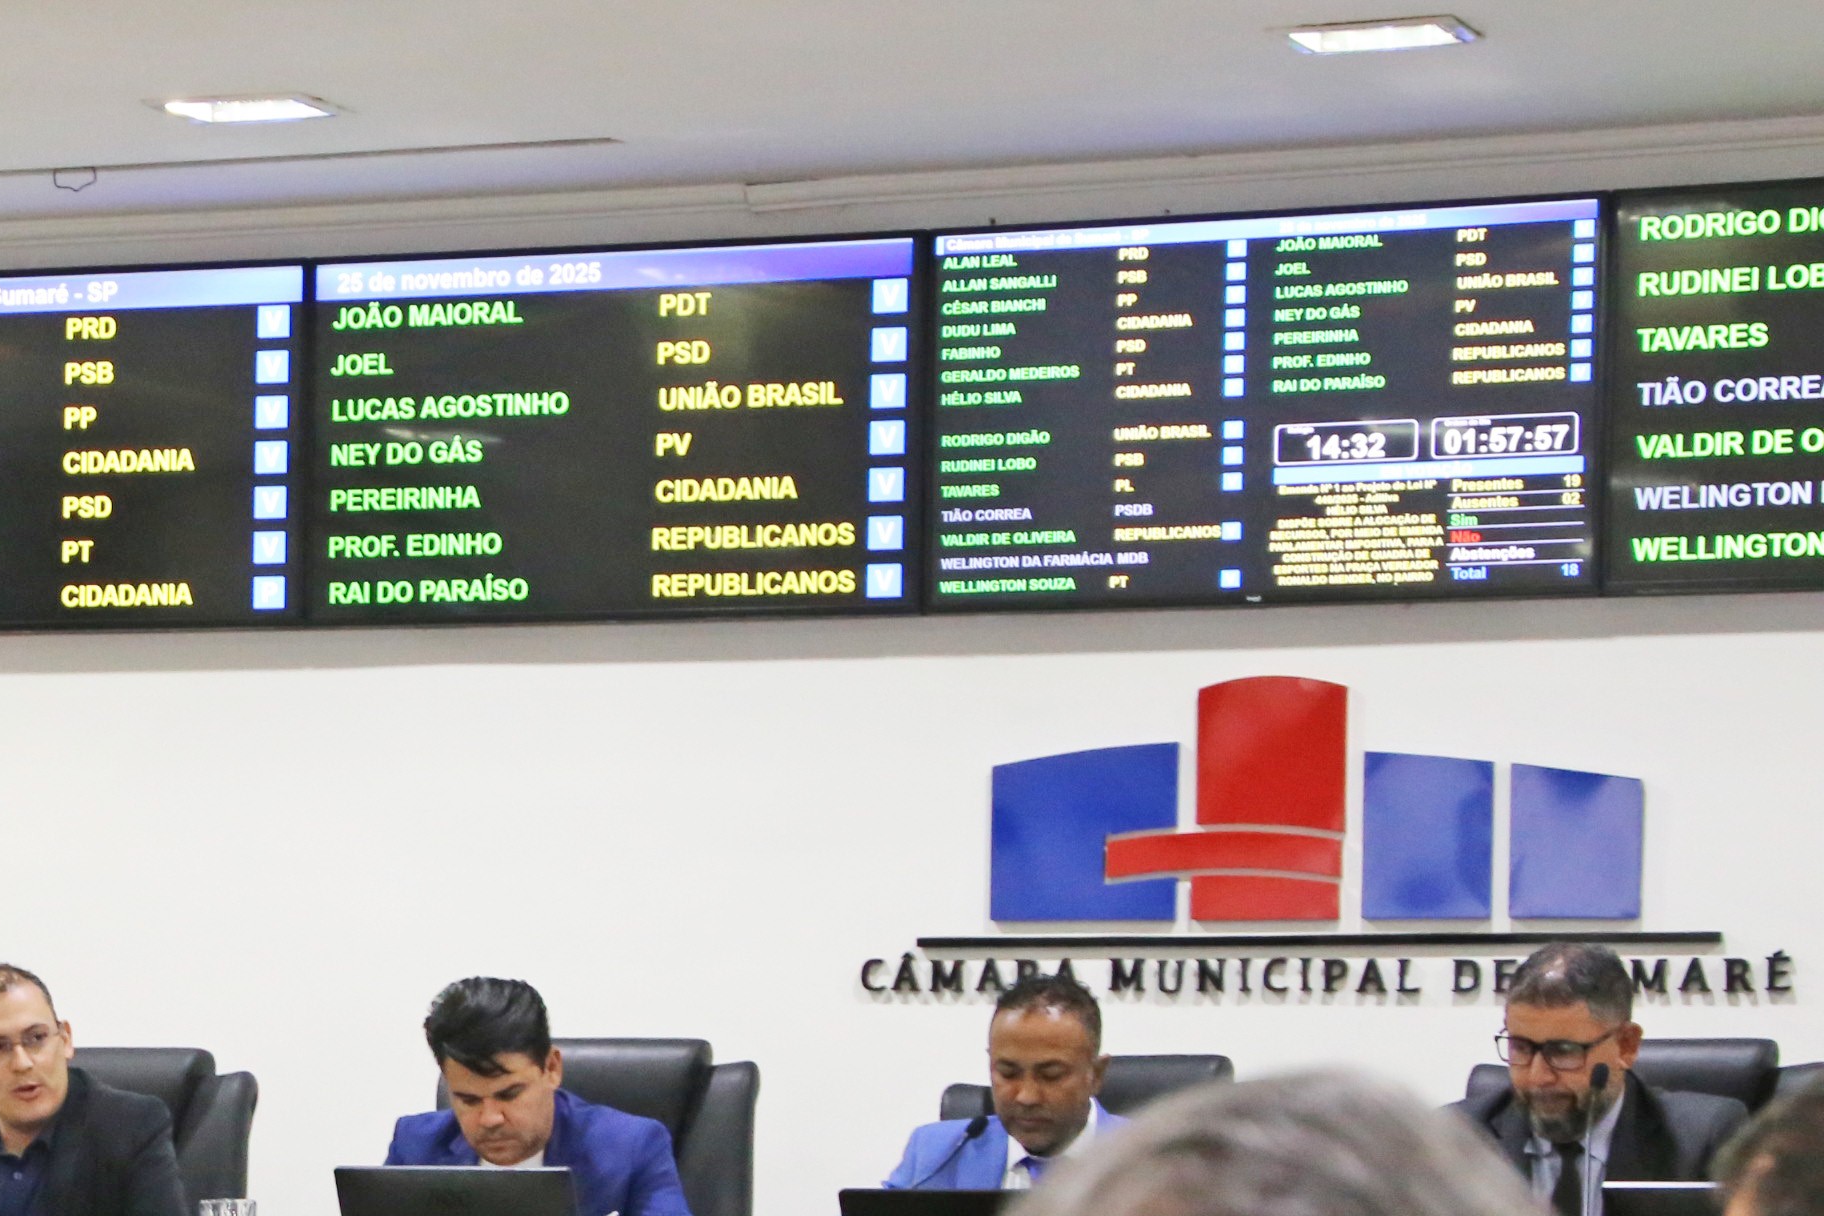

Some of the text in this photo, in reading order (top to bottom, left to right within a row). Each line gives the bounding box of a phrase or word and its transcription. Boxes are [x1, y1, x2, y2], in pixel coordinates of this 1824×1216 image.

[1640, 207, 1824, 241] RODRIGO DI
[1276, 234, 1383, 252] JOÃO MAIORAL
[1457, 228, 1487, 242] PDT
[943, 254, 1017, 270] ALAN LEAL
[1118, 247, 1149, 261] PRD
[1455, 253, 1486, 266] PSD
[338, 262, 601, 292] 25 de novembro de 2025
[1117, 270, 1147, 284] PSB
[1275, 262, 1311, 276] JOEL
[942, 275, 1057, 292] ALLAN SANGALLI
[1276, 281, 1409, 298] LUCAS AGOSTINHO
[1456, 272, 1559, 290] UNIÃO BRASIL
[1637, 267, 1759, 297] RUDINEI
[88, 282, 117, 302] SP
[1116, 294, 1137, 307] PP
[660, 292, 712, 317] PDT
[942, 298, 1046, 315] CÉSAR BIANCHI
[1274, 303, 1360, 322] NEY DO GÁS
[1454, 299, 1476, 313] PV
[332, 301, 523, 330] JOÃO MAIORAL
[1116, 314, 1192, 330] CIDADANIA
[66, 317, 116, 340] PRD
[942, 323, 1016, 338] DUDU LIMA
[1454, 320, 1534, 336] CIDADANIA
[1273, 329, 1359, 345] PEREIRINHA
[1637, 323, 1768, 352] TAVARES
[657, 341, 710, 365] PSD
[941, 346, 1001, 360] FABINHO
[1116, 339, 1146, 353] PSD
[1452, 343, 1565, 360] REPUBLICANOS
[330, 353, 394, 376] JOEL
[1115, 362, 1135, 376] PT
[1272, 353, 1371, 369] PROF. EDINHO
[65, 361, 114, 385] PSB
[941, 365, 1080, 383] GERALDO MEDEIROS
[1452, 367, 1565, 384] REPUBLICANOS
[1115, 383, 1191, 399] CIDADANIA
[1272, 373, 1385, 393] RAI DO PARAÍSO
[1637, 375, 1824, 405] TIÃO CORRE
[659, 381, 843, 411] UNIÃO BRASIL
[941, 391, 1022, 406] HÉLIO SILVA
[332, 392, 569, 422] LUCAS AGOSTINHO
[64, 407, 97, 430] PP
[941, 430, 1050, 447] RODRIGO DIGÃO
[1115, 425, 1212, 440] UNIÃO BRASIL
[1444, 424, 1569, 455] 01:57:57
[331, 435, 483, 466] NEY DO GÁS
[656, 433, 692, 456] PV
[1307, 432, 1386, 460] 14:32
[1636, 429, 1793, 459] VALDIR DE
[63, 448, 195, 474] CIDADANIA
[940, 457, 1036, 472] RUDINEI LOBO
[1114, 453, 1144, 466] PSB
[655, 476, 798, 503] CIDADANIA
[1114, 479, 1134, 492] PL
[1452, 478, 1524, 492] Presentes
[1564, 475, 1581, 488] 19
[330, 486, 481, 511] PEREIRINHA
[941, 484, 1000, 498] TAVARES
[1562, 492, 1581, 505] 02
[1634, 481, 1812, 510] WELINGTON
[62, 496, 112, 519] PSD
[1114, 504, 1153, 516] PSDB
[1452, 496, 1519, 509] Ausentes
[941, 508, 1032, 522] TIÃO CORREA
[1450, 514, 1478, 526] Sim
[652, 522, 855, 550] REPUBLICANOS
[941, 530, 1076, 546] VALDIR DE OLIVEIRA
[1115, 525, 1221, 541] REPUBLICANOS
[1450, 531, 1481, 543] Não
[62, 540, 94, 563] PT
[328, 532, 502, 558] PROF. EDINHO
[1451, 546, 1535, 561] Abstenções
[1632, 532, 1824, 562] WELLINGTON
[941, 551, 1113, 570] WELINGTON DA FARMÁCIA
[1117, 552, 1148, 564] MDB
[1451, 566, 1487, 580] Total
[1561, 564, 1579, 576] 18
[329, 573, 528, 604] RAI DO PARAÍSO
[652, 570, 855, 597] REPUBLICANOS
[939, 578, 1076, 593] WELLINGTON SOUZA
[1109, 576, 1129, 588] PT
[61, 583, 193, 607] CIDADANIA
[1109, 957, 1420, 994] MUNICIPAL
